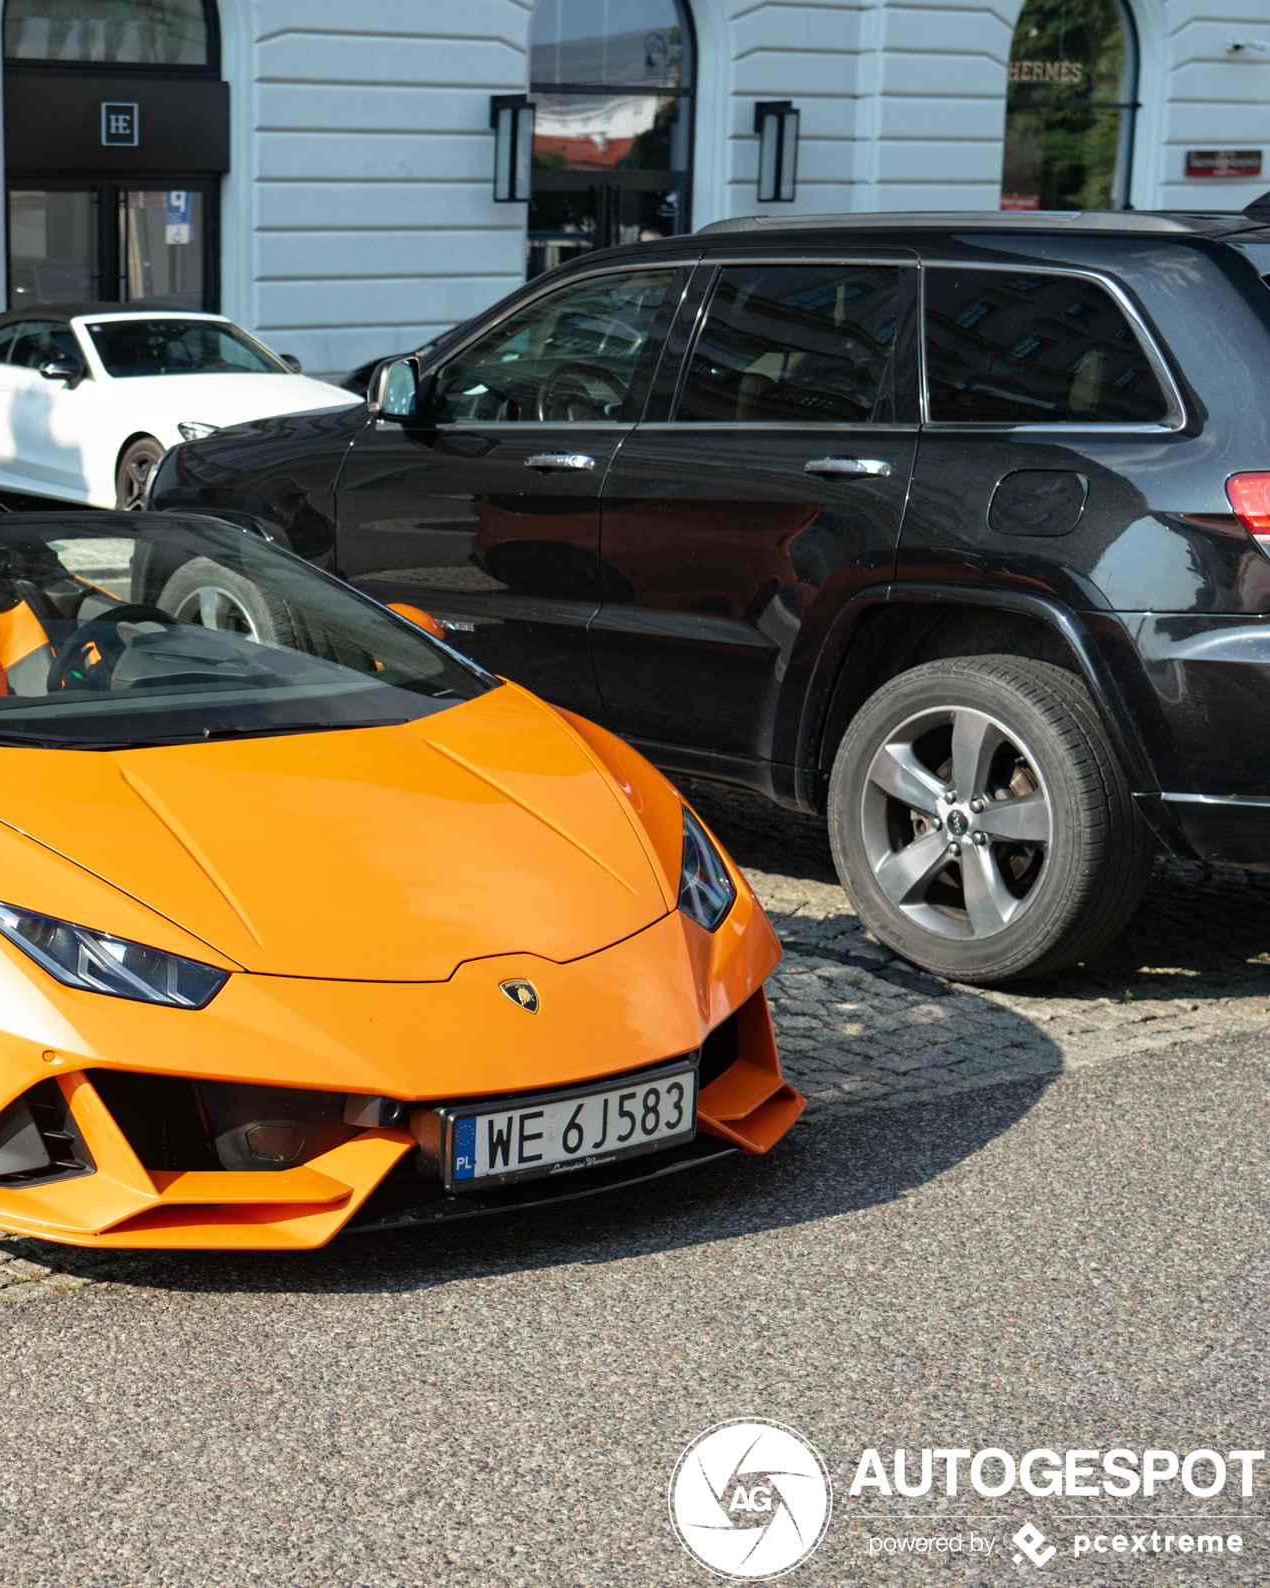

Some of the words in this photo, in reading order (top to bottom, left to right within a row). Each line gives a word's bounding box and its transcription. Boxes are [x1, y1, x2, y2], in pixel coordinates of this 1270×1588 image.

[488, 1111, 544, 1169] WE
[562, 1082, 684, 1154] 6J583
[456, 1156, 472, 1170] PL
